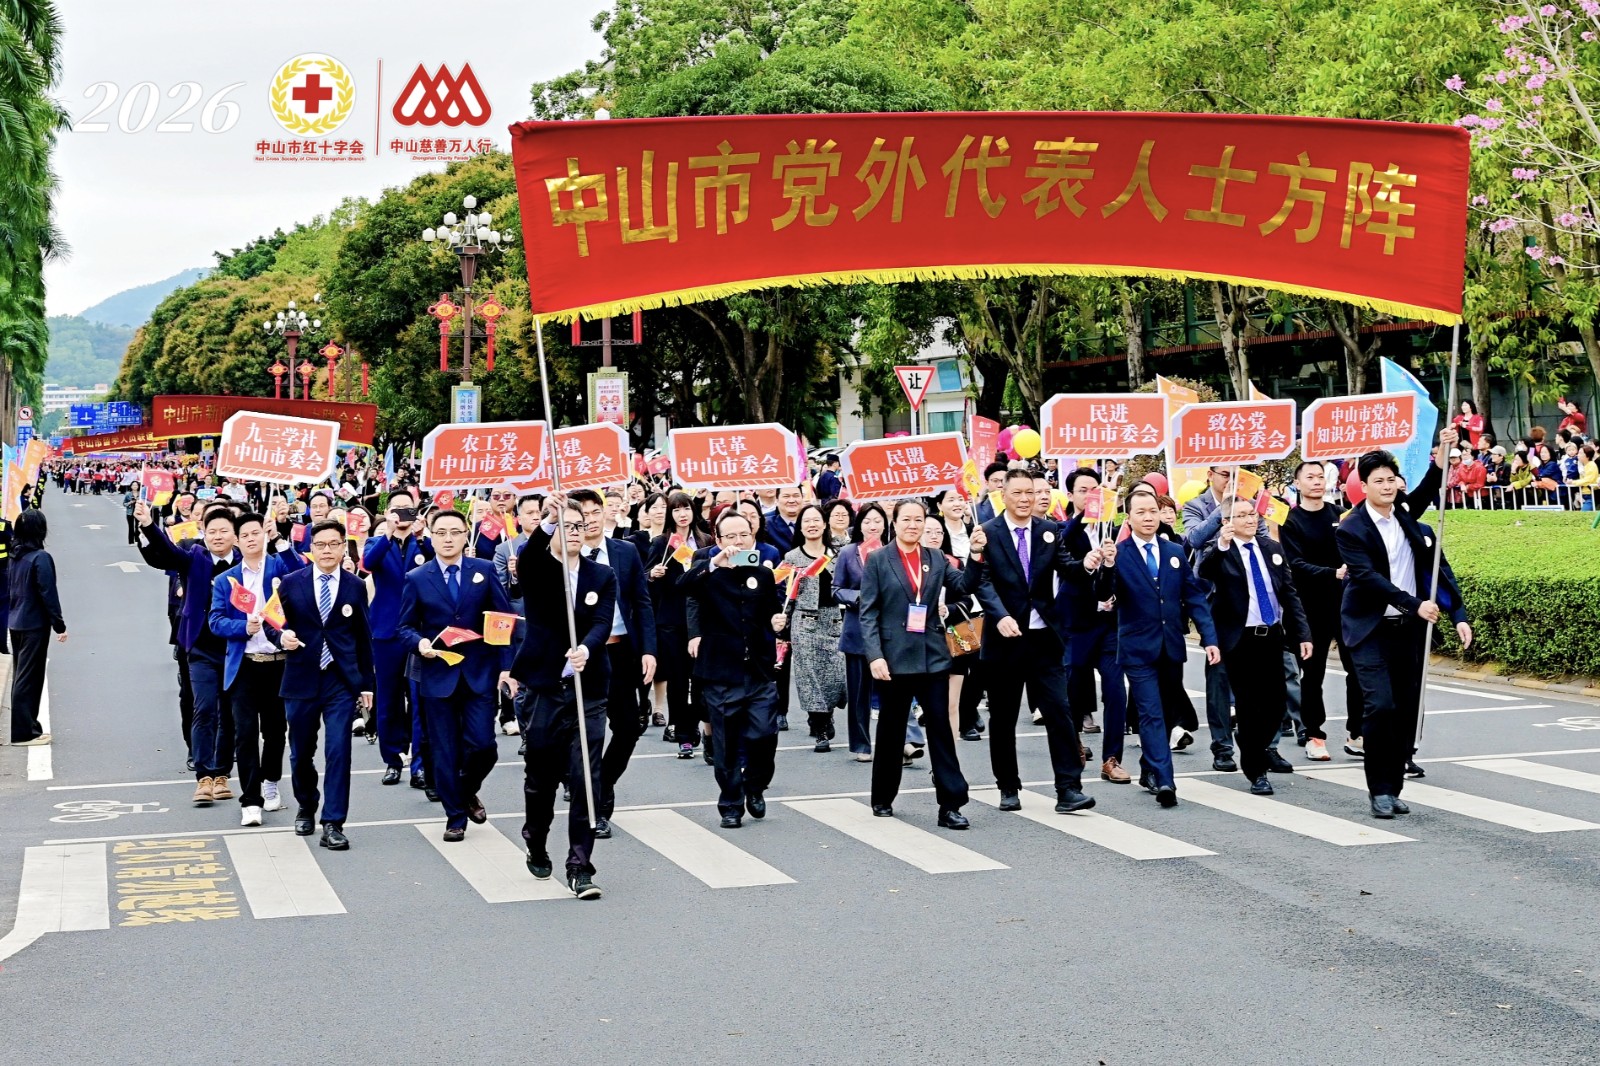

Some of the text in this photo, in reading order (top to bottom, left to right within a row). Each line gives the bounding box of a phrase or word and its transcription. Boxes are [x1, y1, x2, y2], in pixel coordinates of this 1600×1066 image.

[544, 135, 1418, 257] 中山市党外代表人士方阵
[908, 372, 922, 389] 让
[1090, 403, 1129, 423] 民进
[1208, 411, 1267, 431] 致公党
[1331, 401, 1398, 425] 中山市党外
[244, 422, 318, 449] 九三学社
[460, 432, 518, 453] 农工党
[1059, 423, 1159, 444] 中山市委会
[1188, 429, 1287, 452] 中山市委会
[1316, 419, 1411, 445] 知识分子联谊会
[235, 441, 324, 472] 中山市委会
[708, 435, 748, 456] 民革
[886, 446, 927, 467] 民盟
[440, 451, 535, 475] 中山市委会
[522, 452, 613, 485] 山市委会
[680, 453, 779, 478] 中山市委会
[861, 461, 959, 488] 中山市委会
